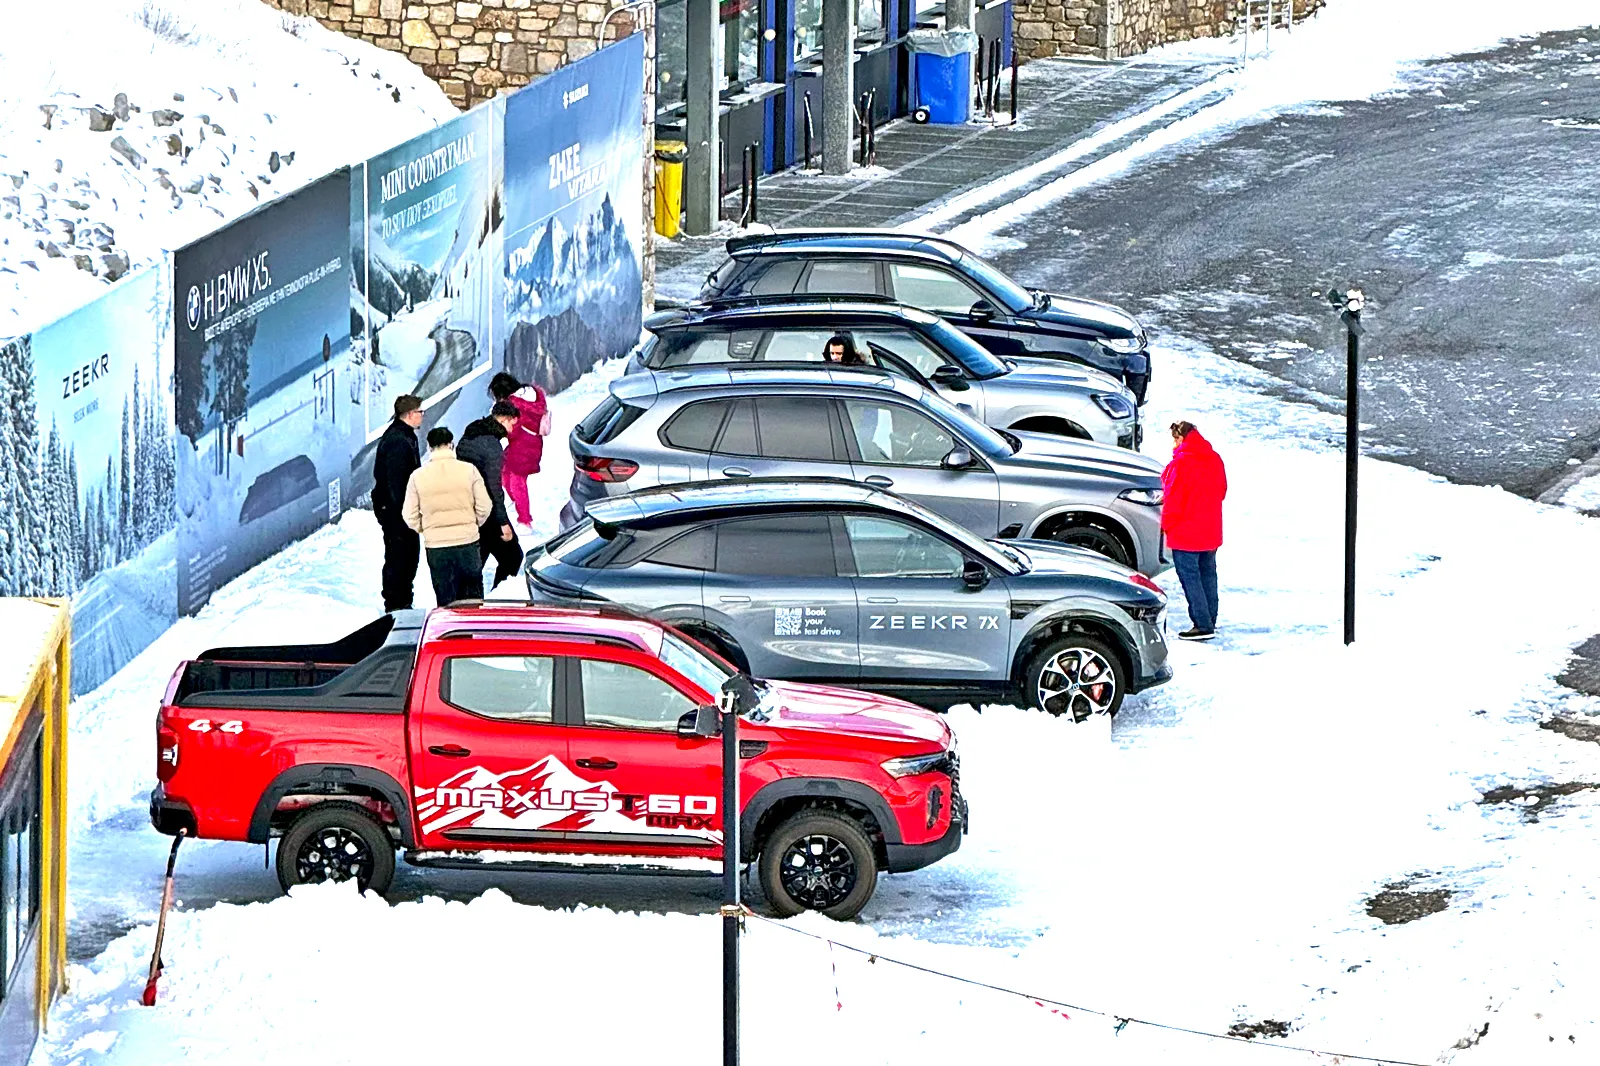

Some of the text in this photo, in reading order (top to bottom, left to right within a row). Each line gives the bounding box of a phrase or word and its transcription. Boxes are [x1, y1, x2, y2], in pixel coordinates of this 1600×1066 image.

[381, 165, 407, 204] MINI
[217, 260, 250, 313] BMW
[62, 353, 109, 399] ZEEKR
[805, 607, 827, 617] Book
[804, 618, 824, 628] your
[869, 615, 999, 630] ZEEKR 7X
[804, 626, 842, 636] test drive
[436, 787, 608, 812] MAXUS
[645, 813, 714, 829] MAX
